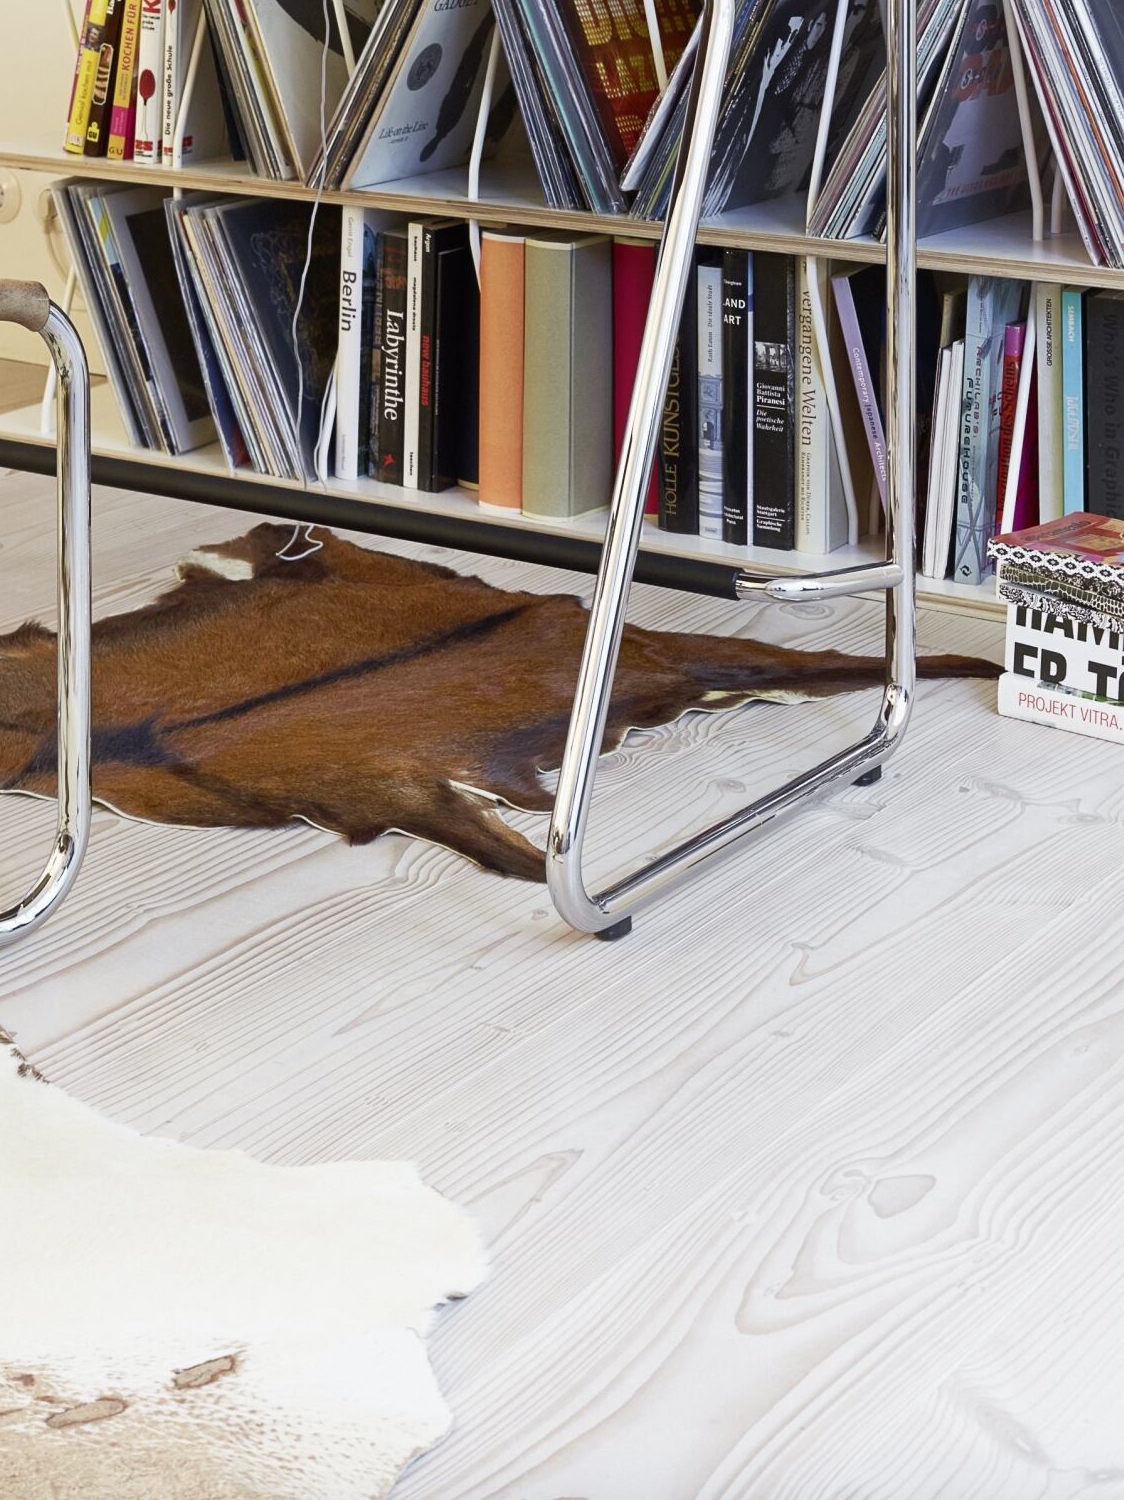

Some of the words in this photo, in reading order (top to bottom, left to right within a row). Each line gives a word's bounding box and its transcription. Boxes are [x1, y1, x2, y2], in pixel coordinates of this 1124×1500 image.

[127, 4, 138, 22] FÜR
[122, 28, 135, 71] KOCHEN
[166, 74, 174, 98] große
[341, 270, 357, 332] Berlin
[723, 298, 746, 309] AND
[723, 314, 742, 326] ART
[1067, 304, 1075, 342] SEMBACH
[421, 335, 431, 359] new
[799, 291, 813, 385] vergangene
[381, 309, 405, 421] Labyrinthe
[421, 361, 431, 406] bauhaus
[756, 382, 786, 392] Giovanni
[756, 389, 782, 398] Battista
[1104, 374, 1120, 415] Who
[756, 395, 786, 406] Piranesi
[756, 409, 768, 417] Die
[756, 416, 785, 425] poetische
[801, 389, 817, 446] Welten
[852, 347, 870, 403] Contemporary
[866, 404, 879, 439] Japanese
[875, 442, 887, 481] Architects
[756, 423, 784, 433] Wahrheit
[1104, 422, 1121, 439] in
[665, 464, 677, 515] HOLLE
[1018, 691, 1077, 720] PROJEKT
[1080, 707, 1124, 732] VITRA.
